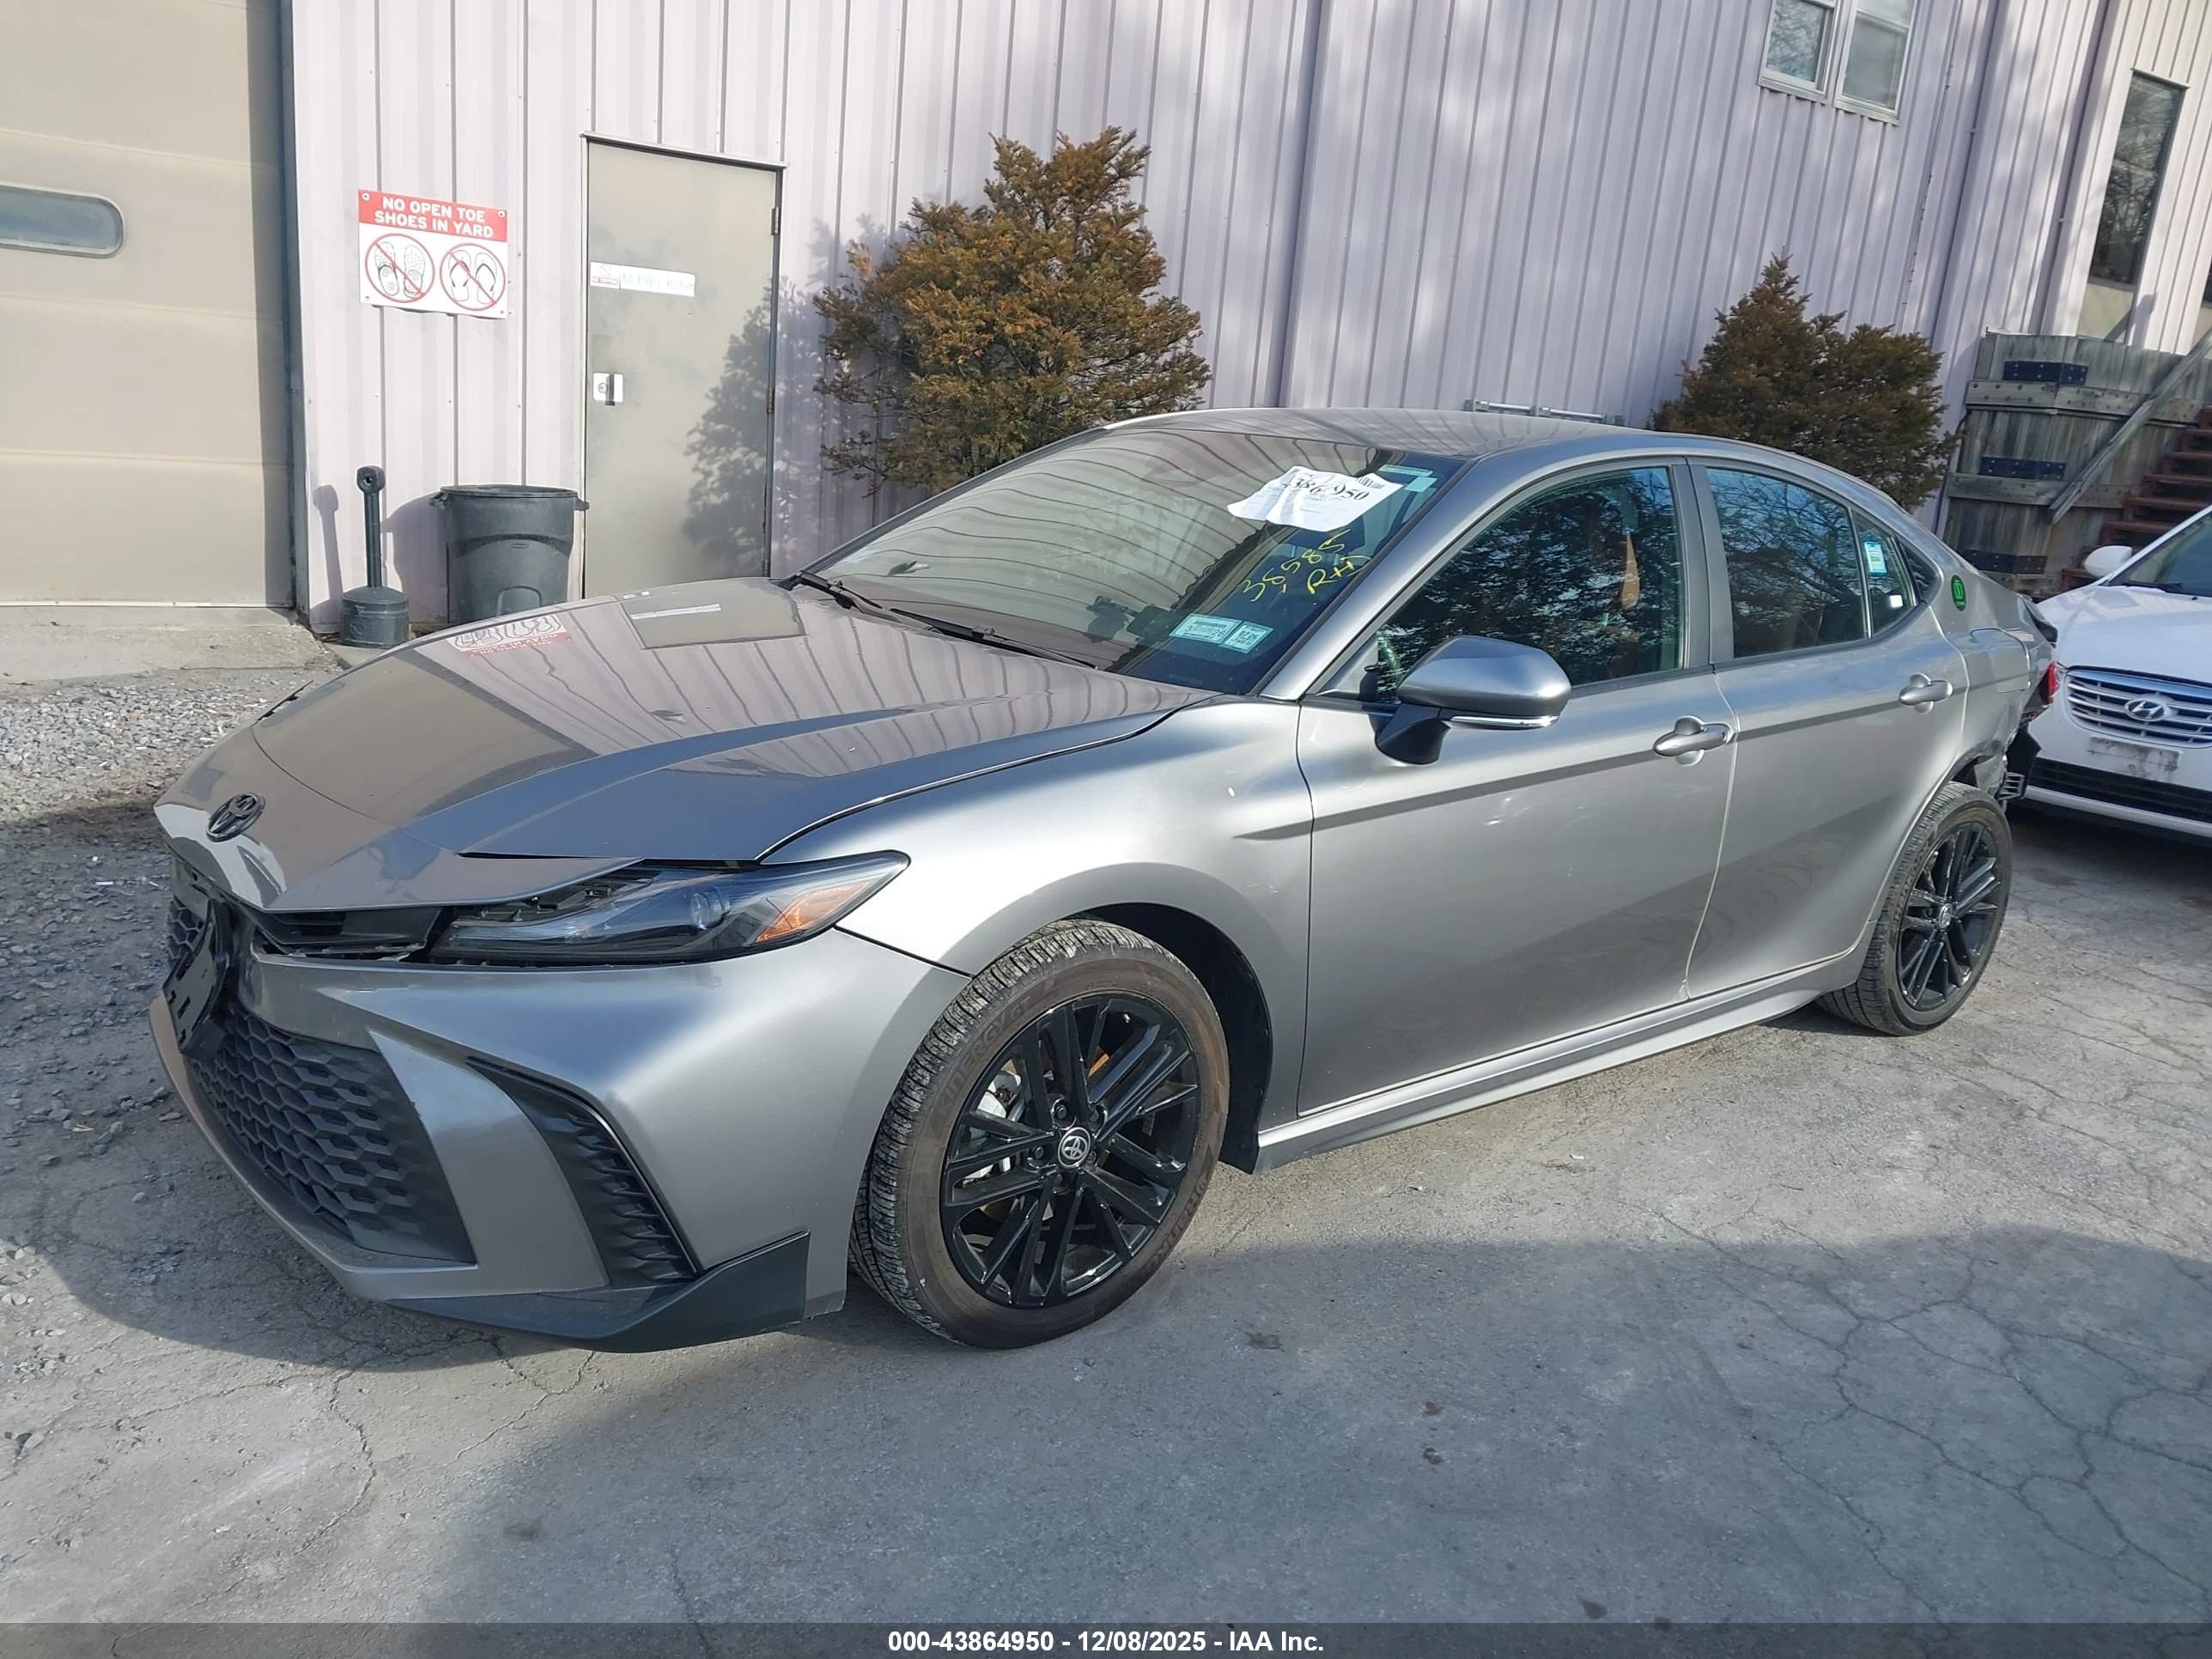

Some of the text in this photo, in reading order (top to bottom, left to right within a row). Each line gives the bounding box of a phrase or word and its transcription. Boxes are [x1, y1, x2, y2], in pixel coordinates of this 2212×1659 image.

[382, 196, 486, 223] NO OPEN TOE
[374, 210, 494, 238] SHOES IN YARD
